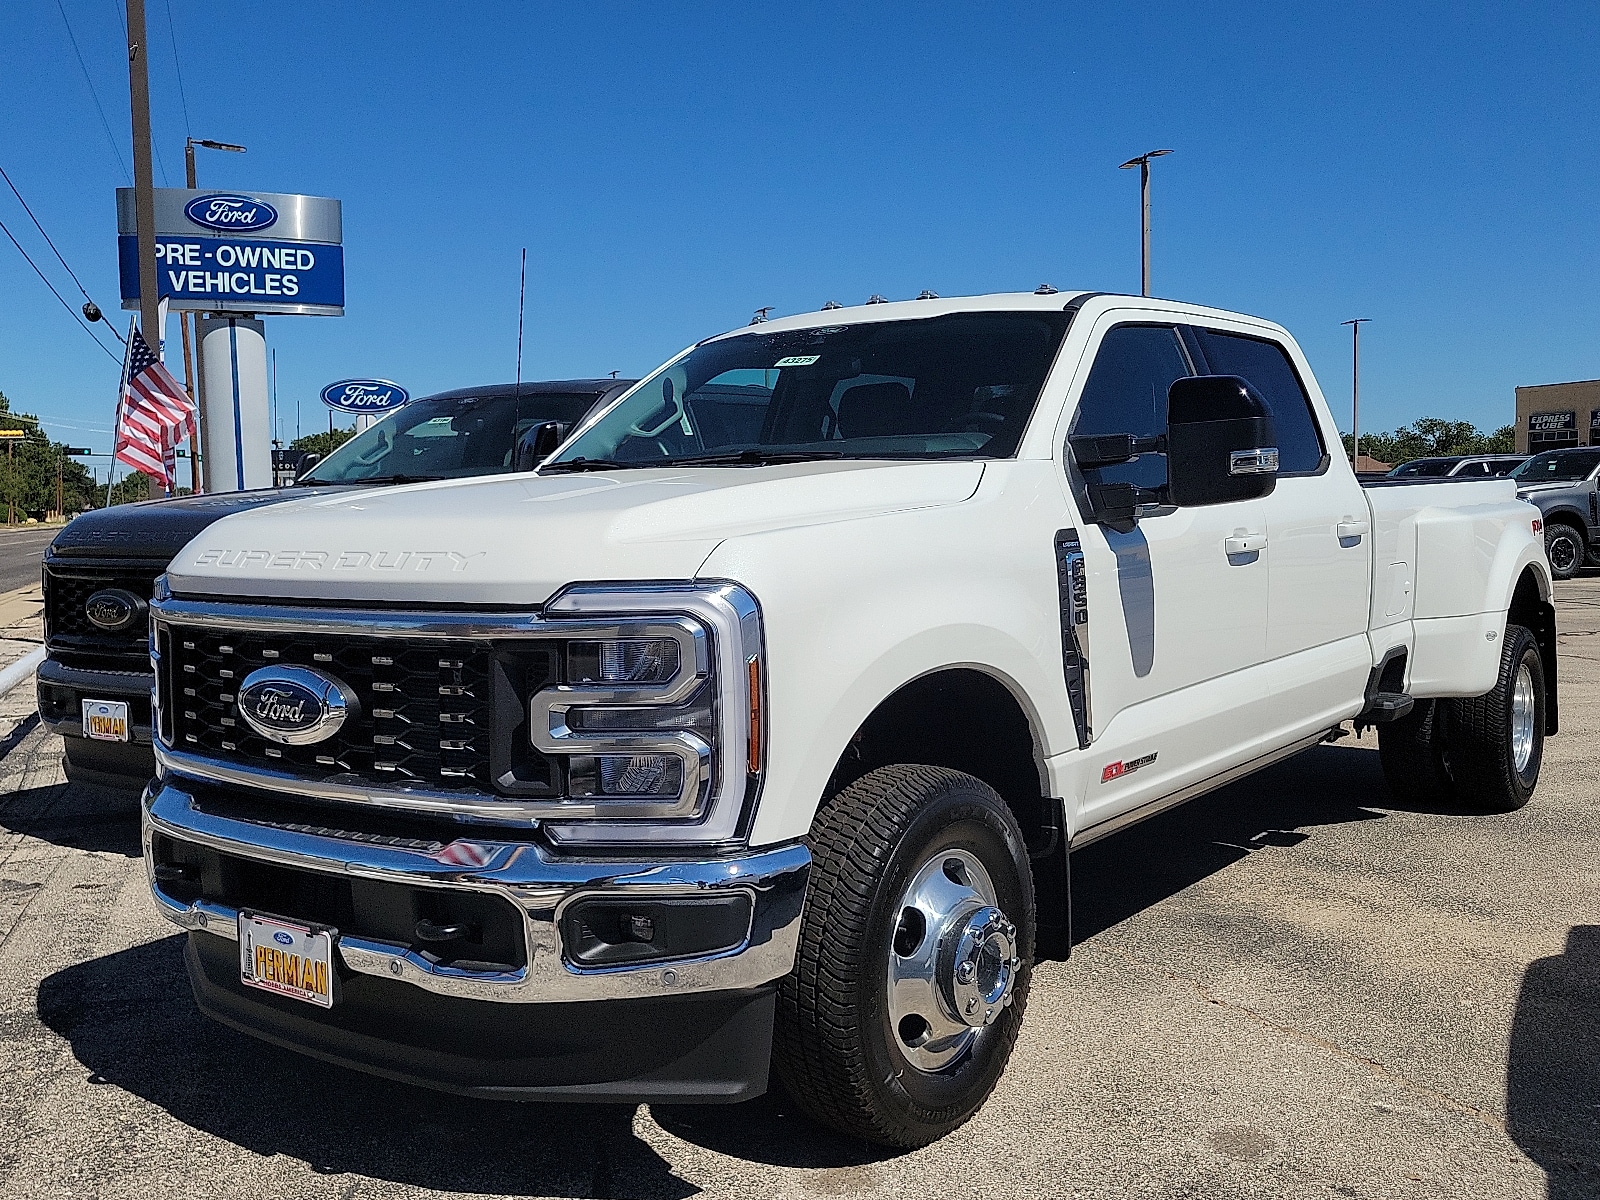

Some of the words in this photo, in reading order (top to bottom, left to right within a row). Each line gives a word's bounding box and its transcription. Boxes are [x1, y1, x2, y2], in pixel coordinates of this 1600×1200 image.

[205, 200, 257, 225] Ford
[168, 270, 299, 296] VEHICLES
[340, 384, 392, 407] Ford
[1531, 413, 1571, 424] EXPRESS
[1536, 422, 1565, 430] LUBE
[194, 549, 330, 571] SUPER
[332, 551, 487, 573] DUTY
[256, 687, 306, 723] Ford
[90, 715, 125, 736] PERMIAN
[255, 944, 328, 996] PERMIAN
